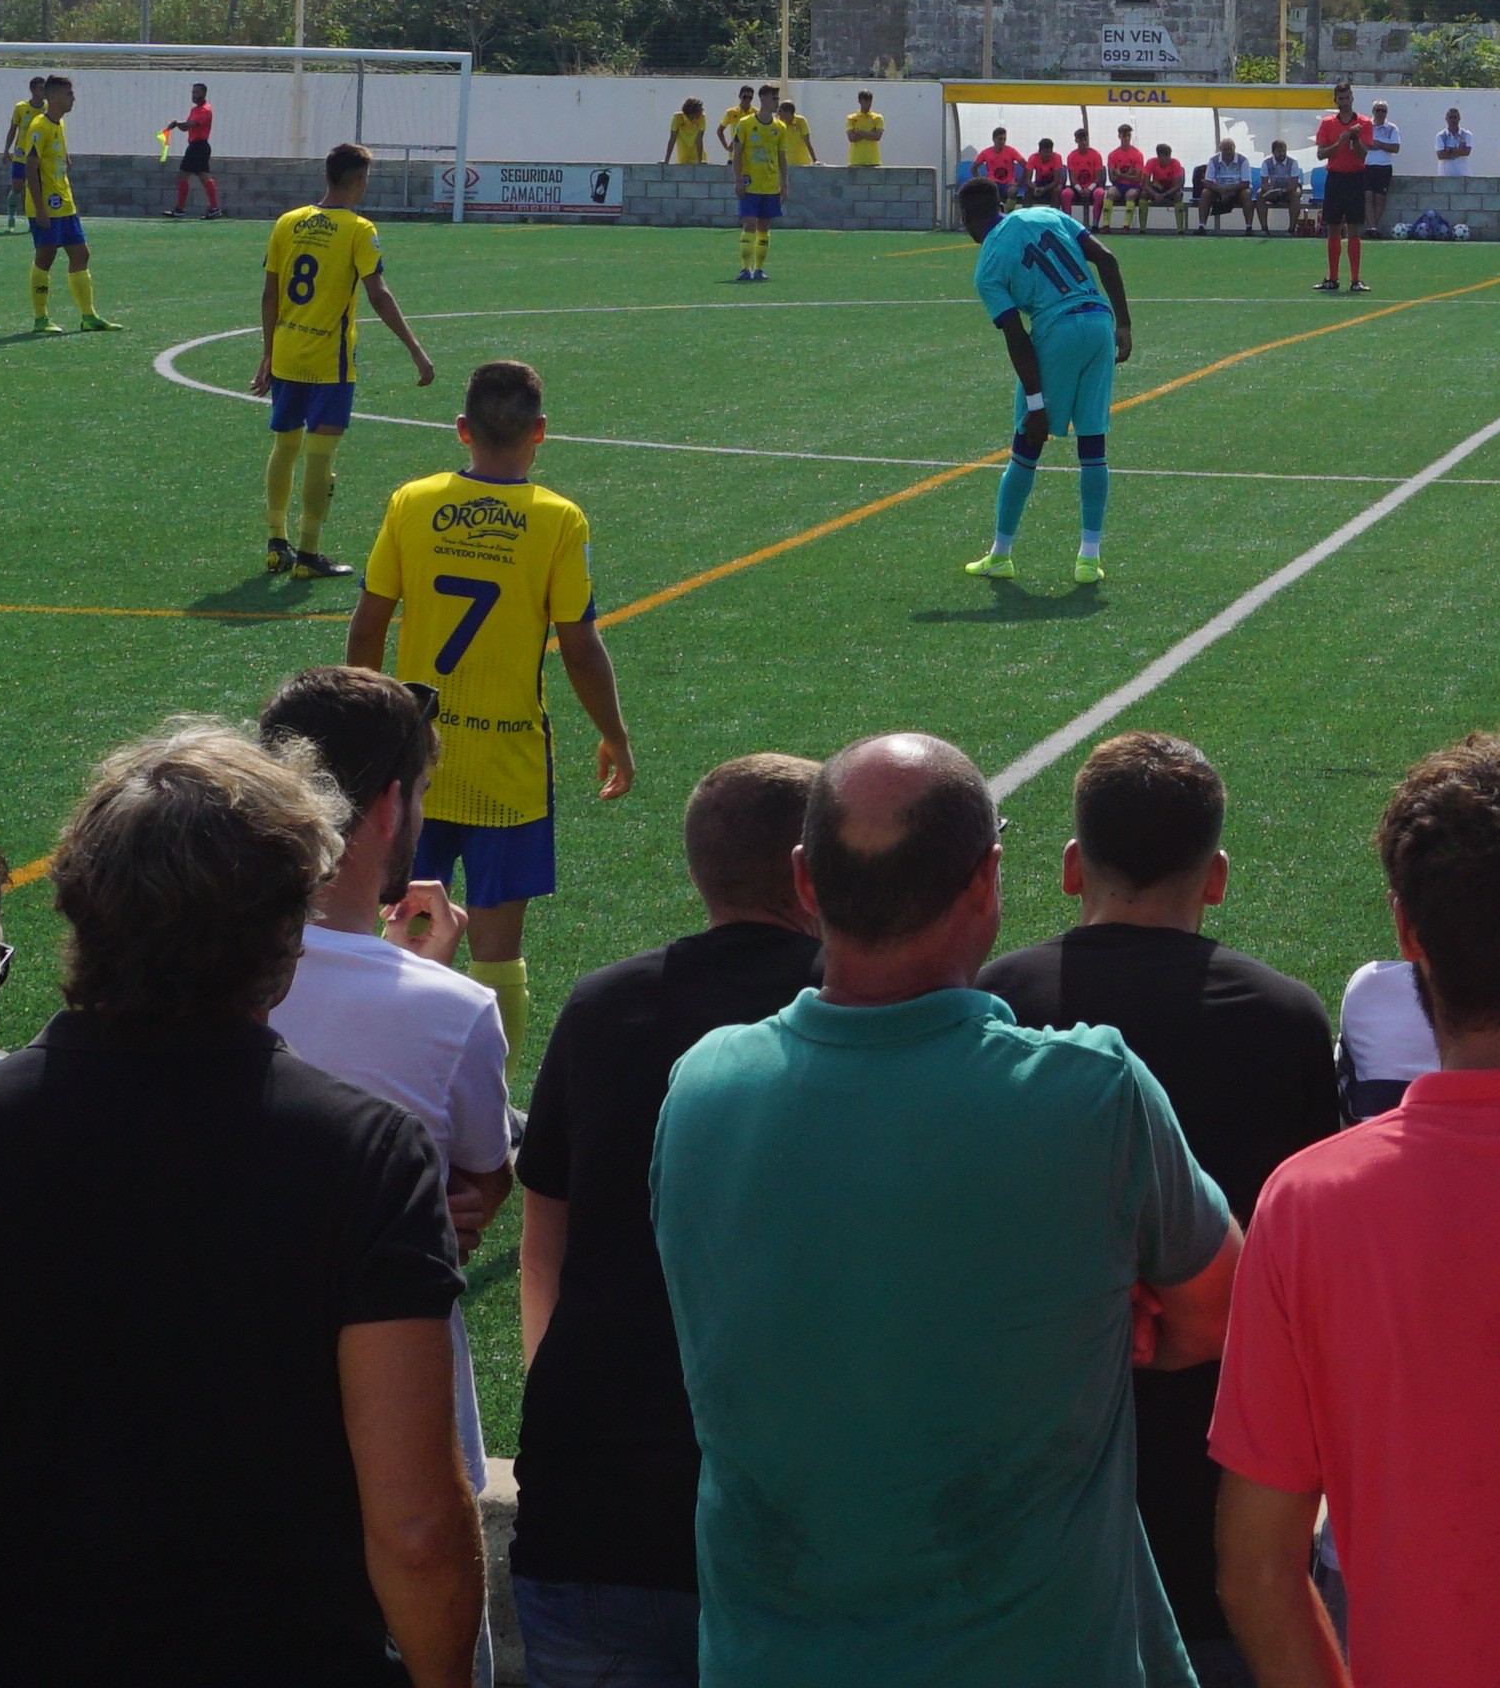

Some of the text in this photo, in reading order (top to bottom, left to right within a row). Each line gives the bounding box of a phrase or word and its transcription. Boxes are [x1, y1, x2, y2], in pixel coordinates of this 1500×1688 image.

[1104, 30, 1125, 43] EN
[1103, 50, 1131, 62] 699
[1135, 50, 1154, 62] 211
[1108, 89, 1172, 103] LOCAL
[500, 168, 564, 184] SEGURIDAD
[501, 185, 562, 204] CAMACHO
[1021, 229, 1088, 294] 11
[287, 254, 319, 306] 8
[432, 503, 528, 533] OROTANA
[433, 545, 476, 559] QUEVEDO
[476, 551, 501, 562] PONS
[434, 574, 501, 676] 7
[439, 709, 461, 726] de
[465, 716, 491, 731] mo
